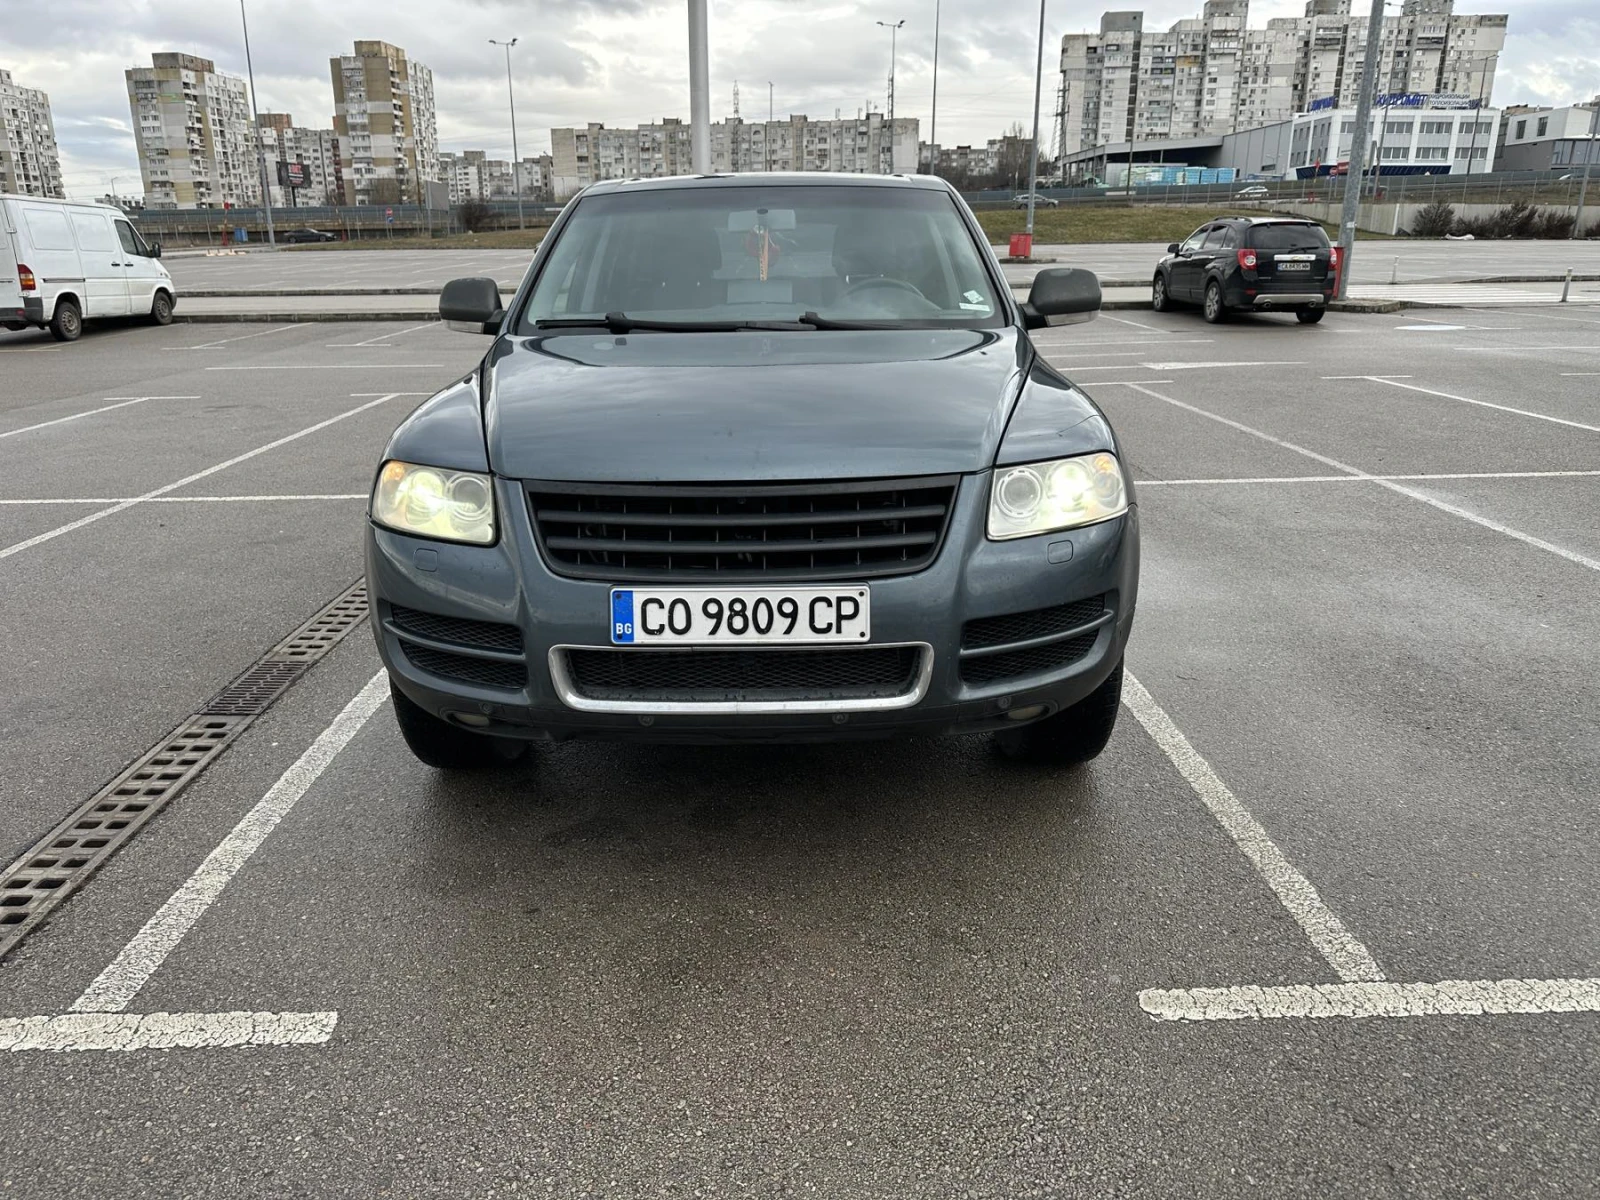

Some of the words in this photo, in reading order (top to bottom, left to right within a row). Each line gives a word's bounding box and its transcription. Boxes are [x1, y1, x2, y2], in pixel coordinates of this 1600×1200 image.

[641, 598, 692, 635] CO
[702, 597, 799, 635] 9809
[809, 596, 860, 634] CP
[616, 623, 632, 634] BG
